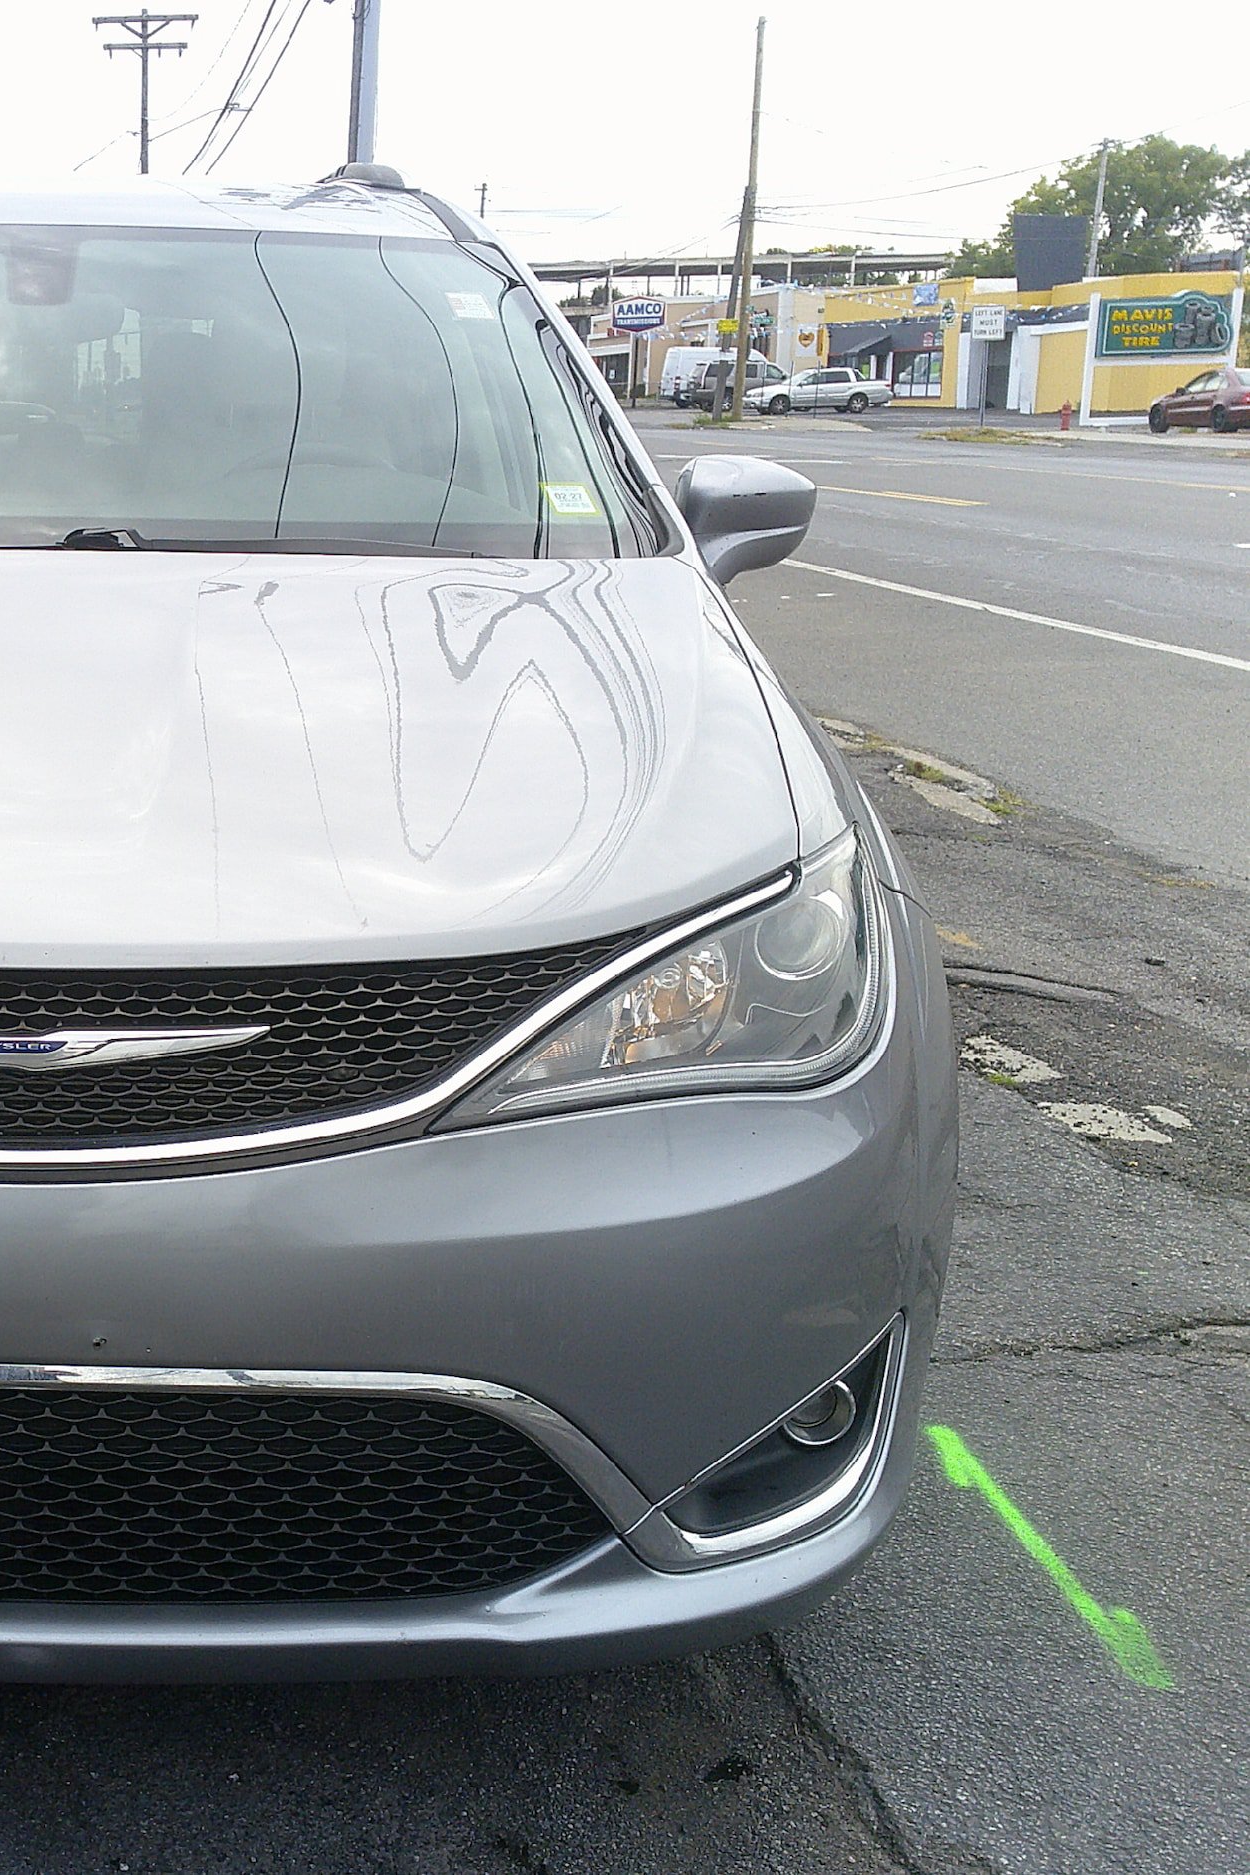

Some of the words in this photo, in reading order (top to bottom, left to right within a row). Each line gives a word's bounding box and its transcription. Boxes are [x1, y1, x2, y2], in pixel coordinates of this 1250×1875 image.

[617, 303, 662, 315] AAMCO
[1111, 308, 1173, 321] MAVIS
[1112, 322, 1174, 335] DISCOUNT
[1121, 336, 1161, 347] TIRE
